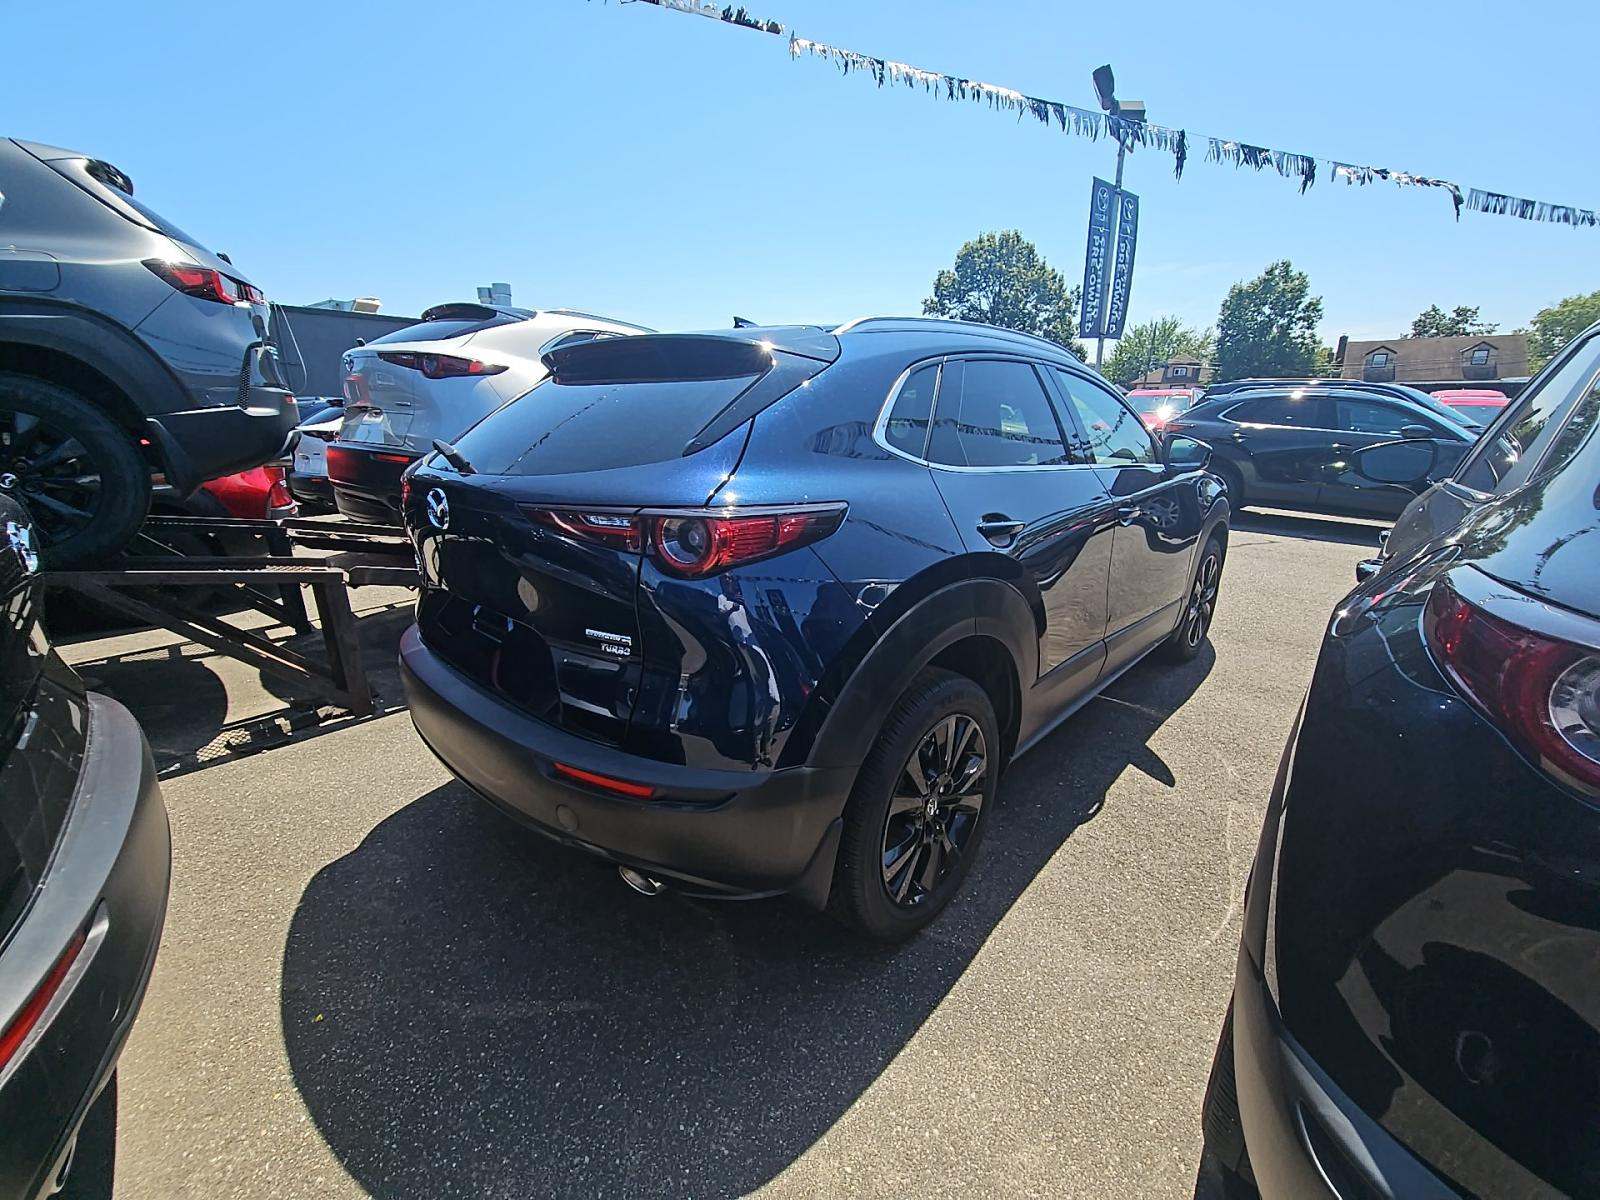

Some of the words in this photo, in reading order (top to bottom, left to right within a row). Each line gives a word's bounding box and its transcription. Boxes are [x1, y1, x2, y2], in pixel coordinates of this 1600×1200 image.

[1085, 235, 1099, 333] PRE-OWNED
[1109, 243, 1126, 334] PRE-OWNED
[600, 643, 631, 656] TURBO
